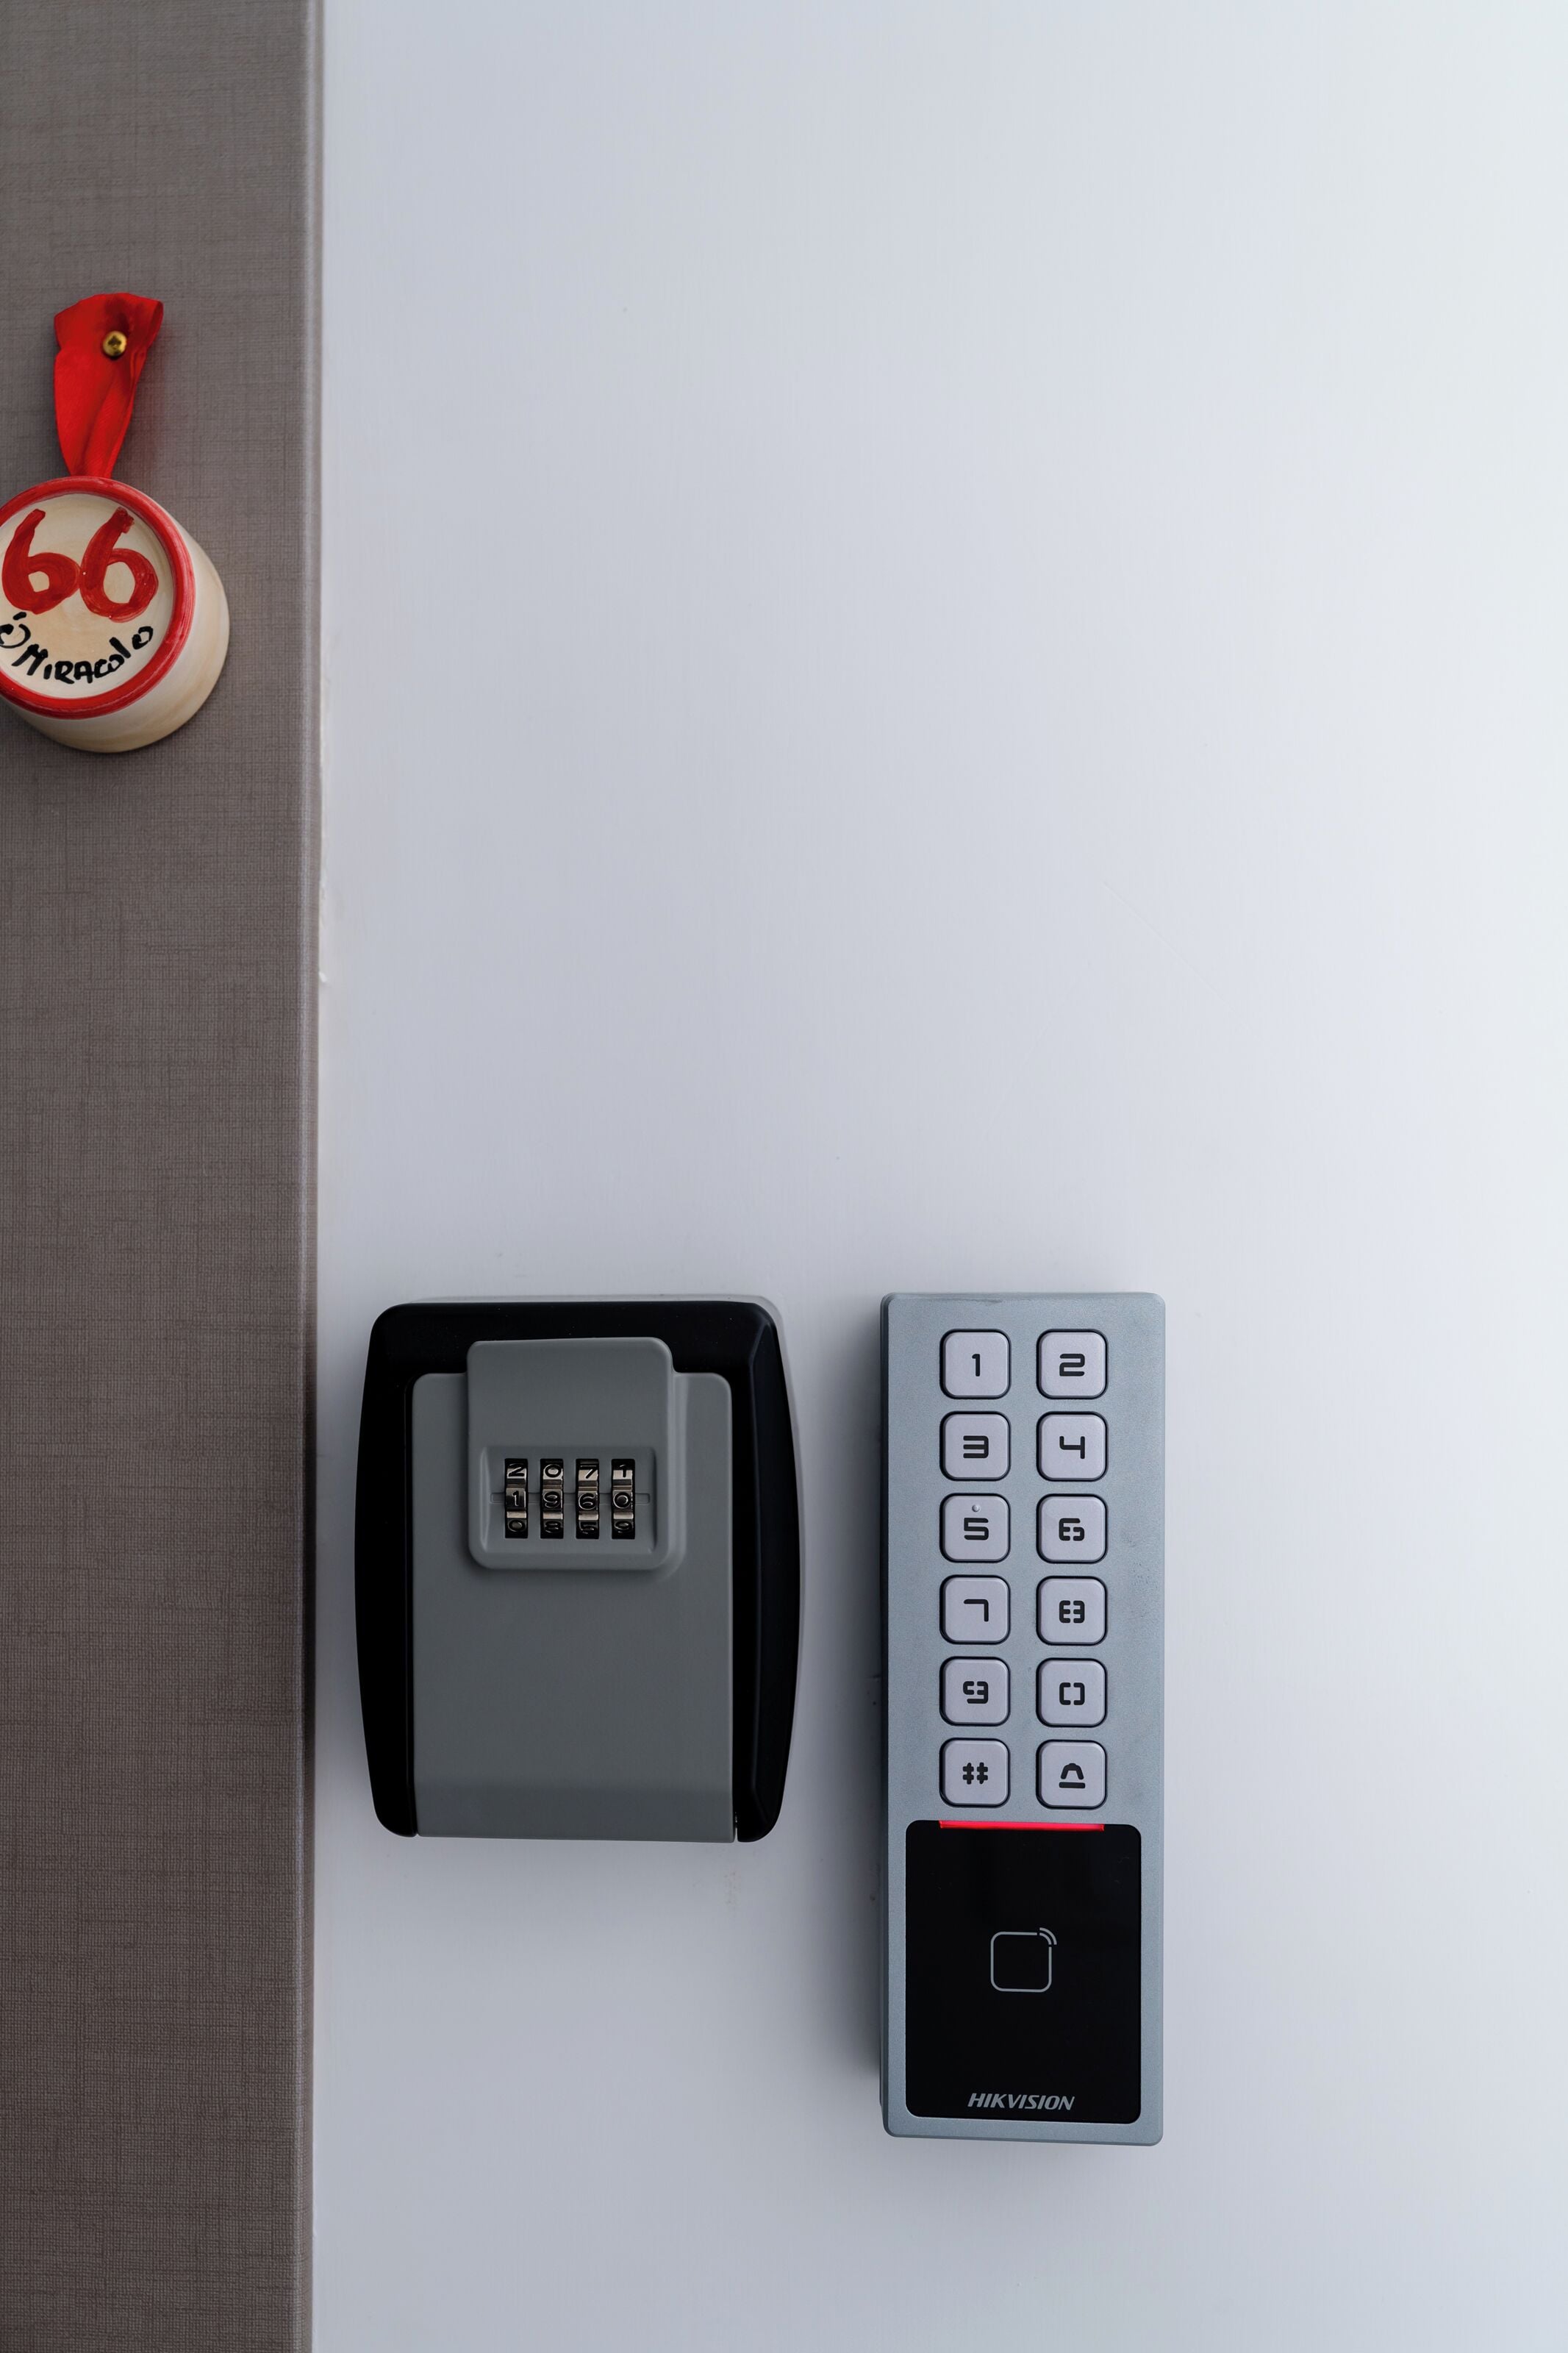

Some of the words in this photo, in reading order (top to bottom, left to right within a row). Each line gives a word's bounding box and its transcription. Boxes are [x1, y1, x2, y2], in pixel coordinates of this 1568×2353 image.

[1, 507, 159, 623] 66
[972, 1353, 981, 1377] 1
[1059, 1353, 1086, 1377] 2
[963, 1435, 989, 1459] 3
[1059, 1435, 1086, 1460] 4
[963, 1517, 989, 1541] 5
[1059, 1518, 1085, 1541] 6
[963, 1599, 989, 1622] 7
[1059, 1600, 1085, 1624] 8
[962, 1680, 989, 1704] 9
[967, 2093, 1075, 2110] HIKVISION
